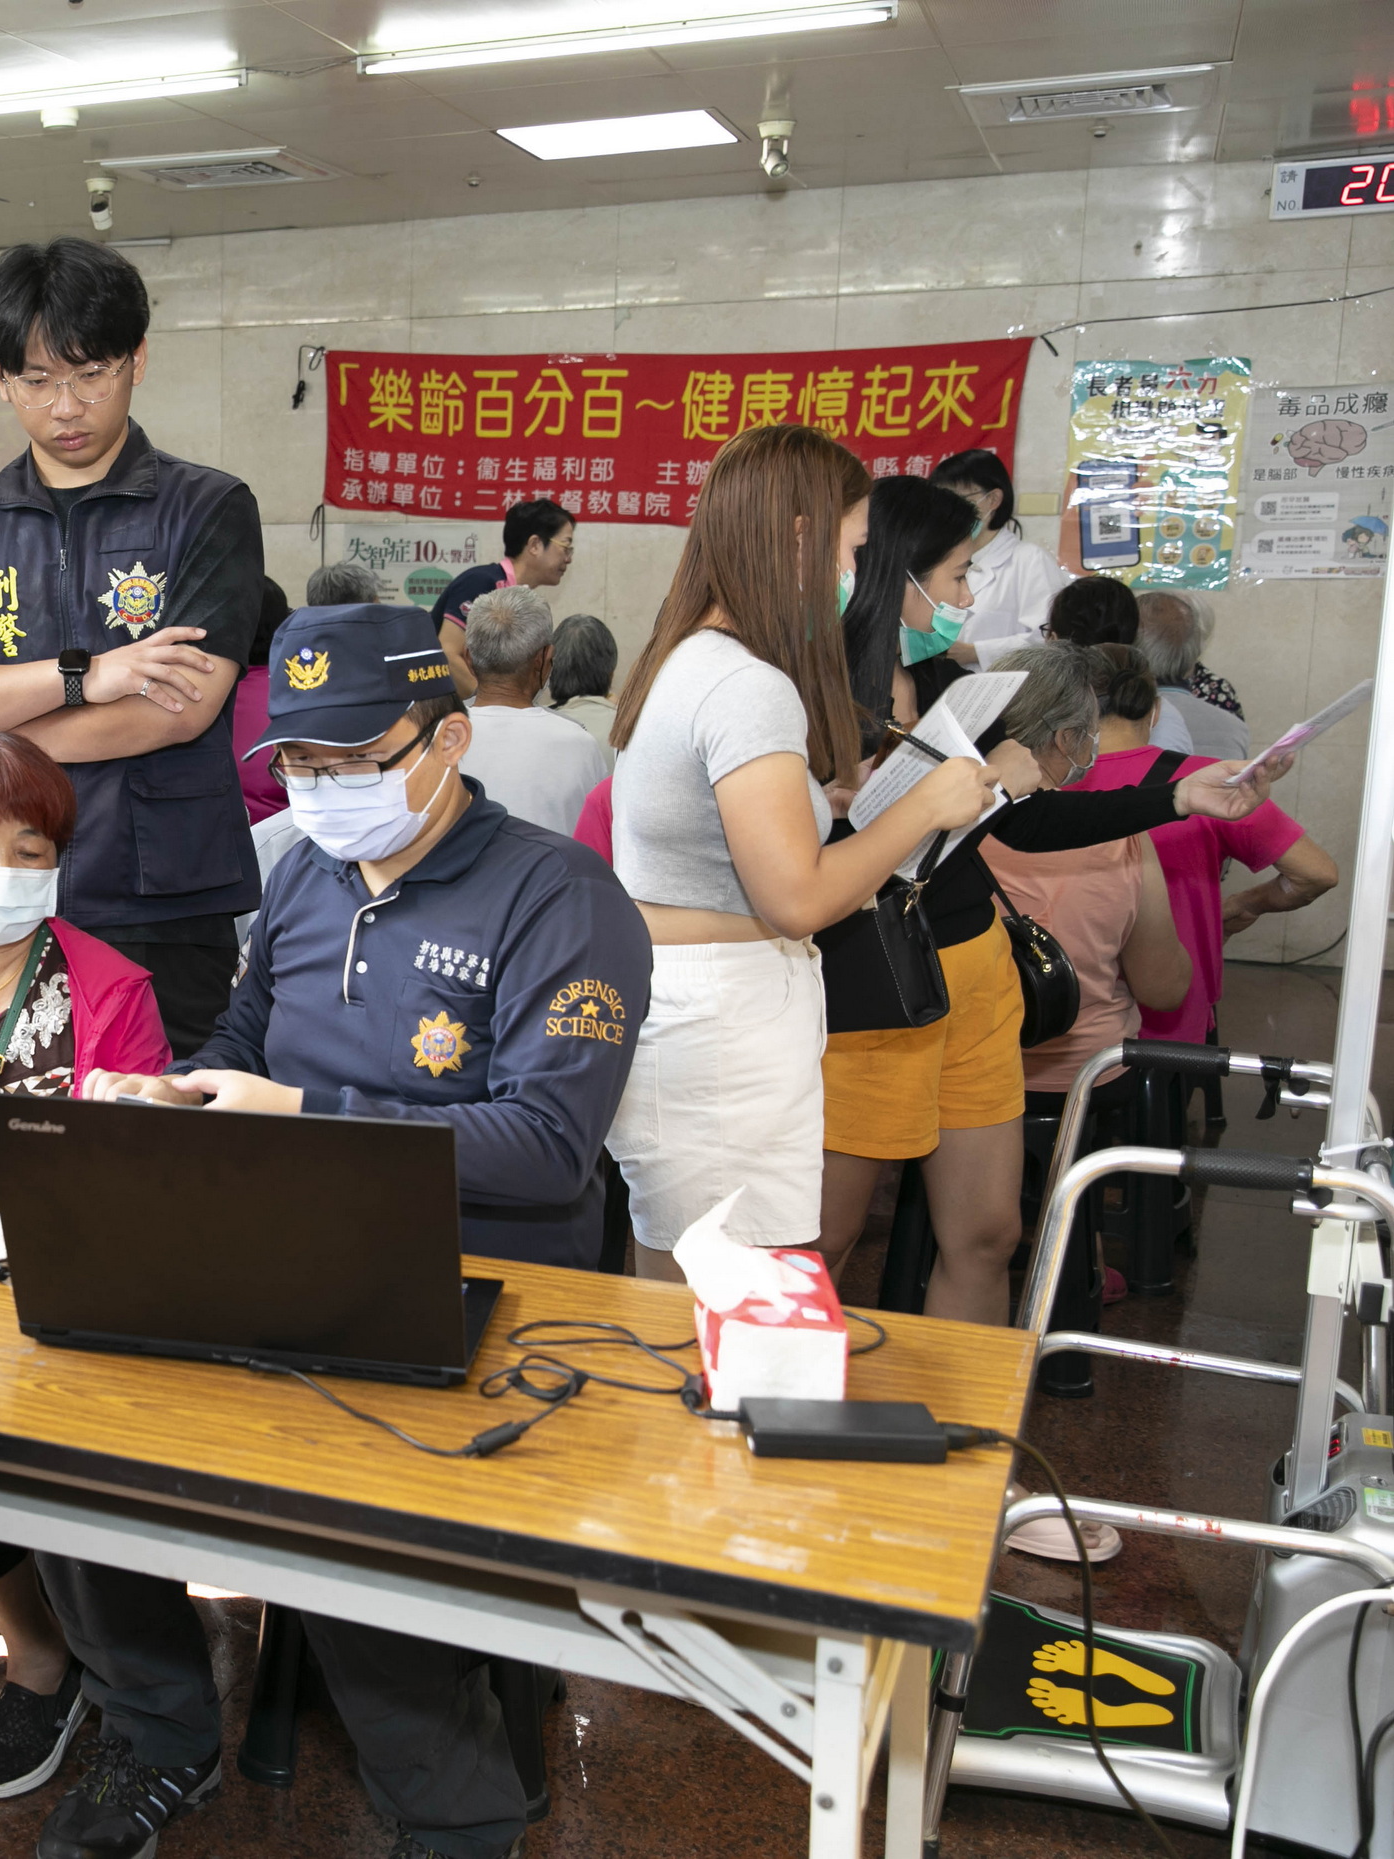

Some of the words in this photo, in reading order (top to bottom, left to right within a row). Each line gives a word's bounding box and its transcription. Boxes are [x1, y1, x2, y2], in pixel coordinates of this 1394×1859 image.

[1280, 169, 1298, 184] 請
[1278, 392, 1389, 417] 毒品成癮
[1253, 468, 1298, 481] 是腦部
[549, 979, 625, 1020] FORENSIC
[546, 1016, 624, 1045] SCIENCE
[8, 1117, 66, 1135] Genuine
